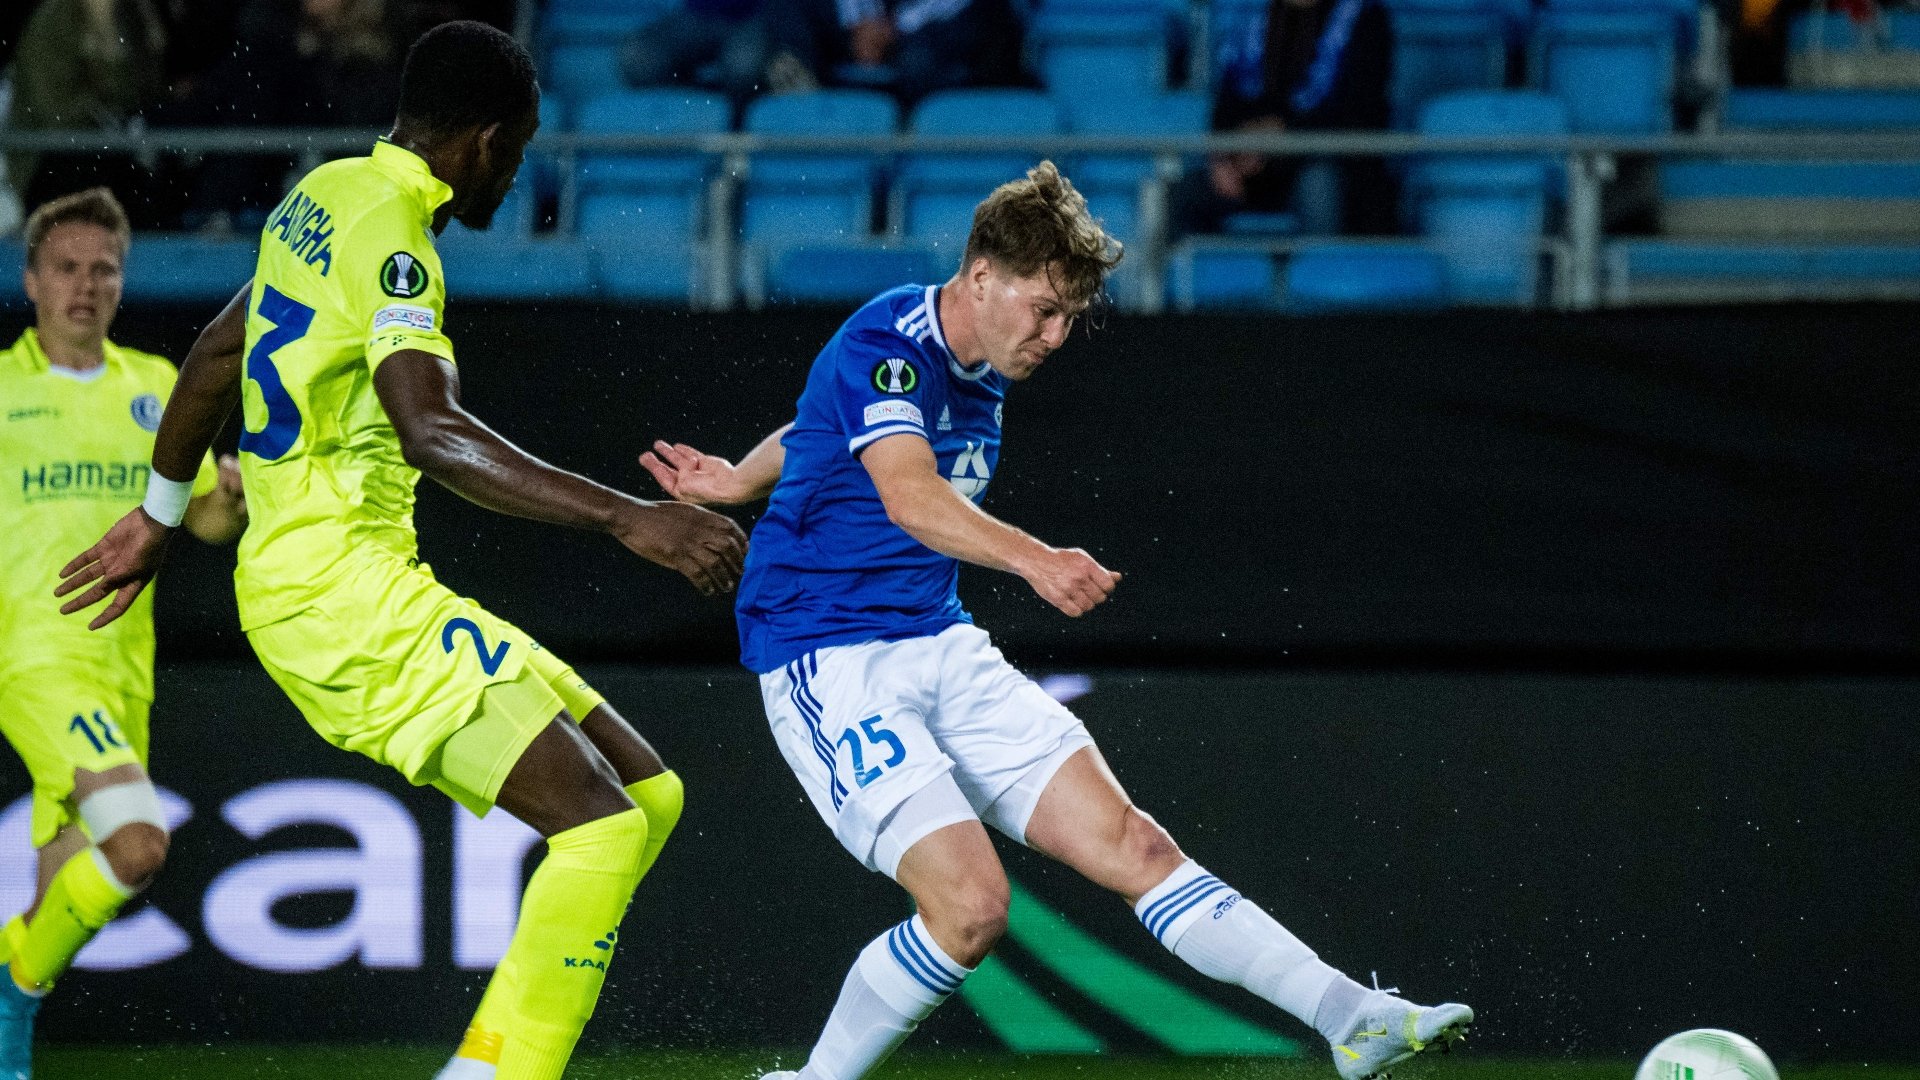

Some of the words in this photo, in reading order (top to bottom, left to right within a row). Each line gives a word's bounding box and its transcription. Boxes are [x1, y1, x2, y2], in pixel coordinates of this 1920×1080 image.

[442, 617, 511, 677] 2
[69, 709, 126, 754] 18
[837, 714, 906, 789] 25
